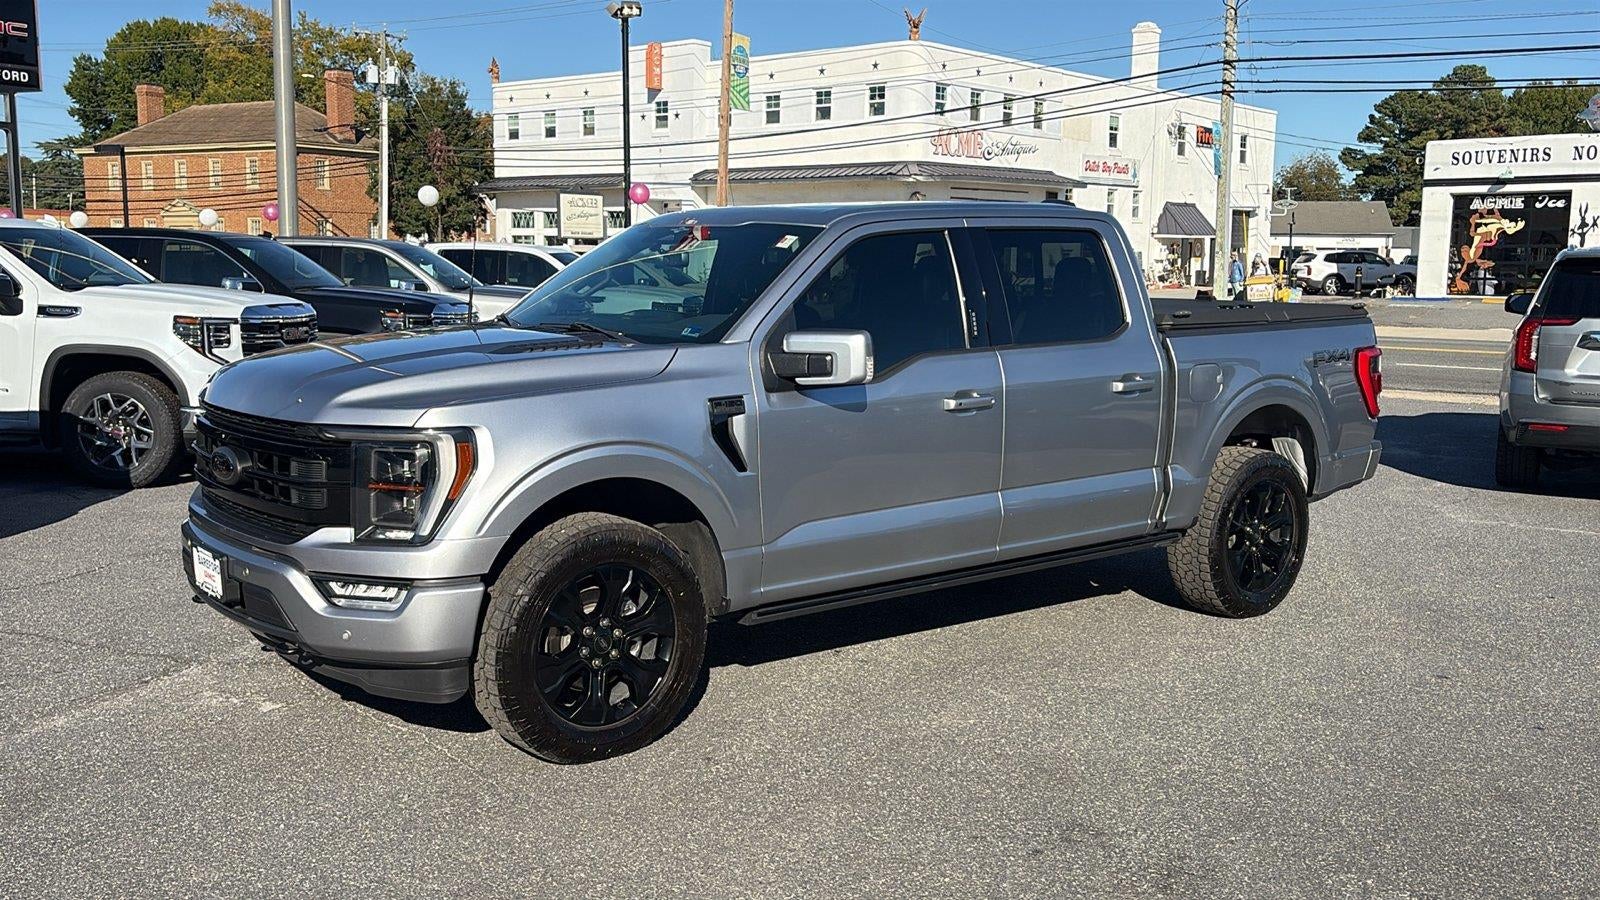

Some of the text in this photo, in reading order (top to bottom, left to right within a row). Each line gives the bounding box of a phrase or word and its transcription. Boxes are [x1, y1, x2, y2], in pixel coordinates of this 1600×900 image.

[930, 128, 1039, 162] ACME Antiques
[1451, 147, 1552, 166] SOUVENIRS
[1469, 195, 1525, 209] ACME
[1312, 348, 1350, 368] FX4
